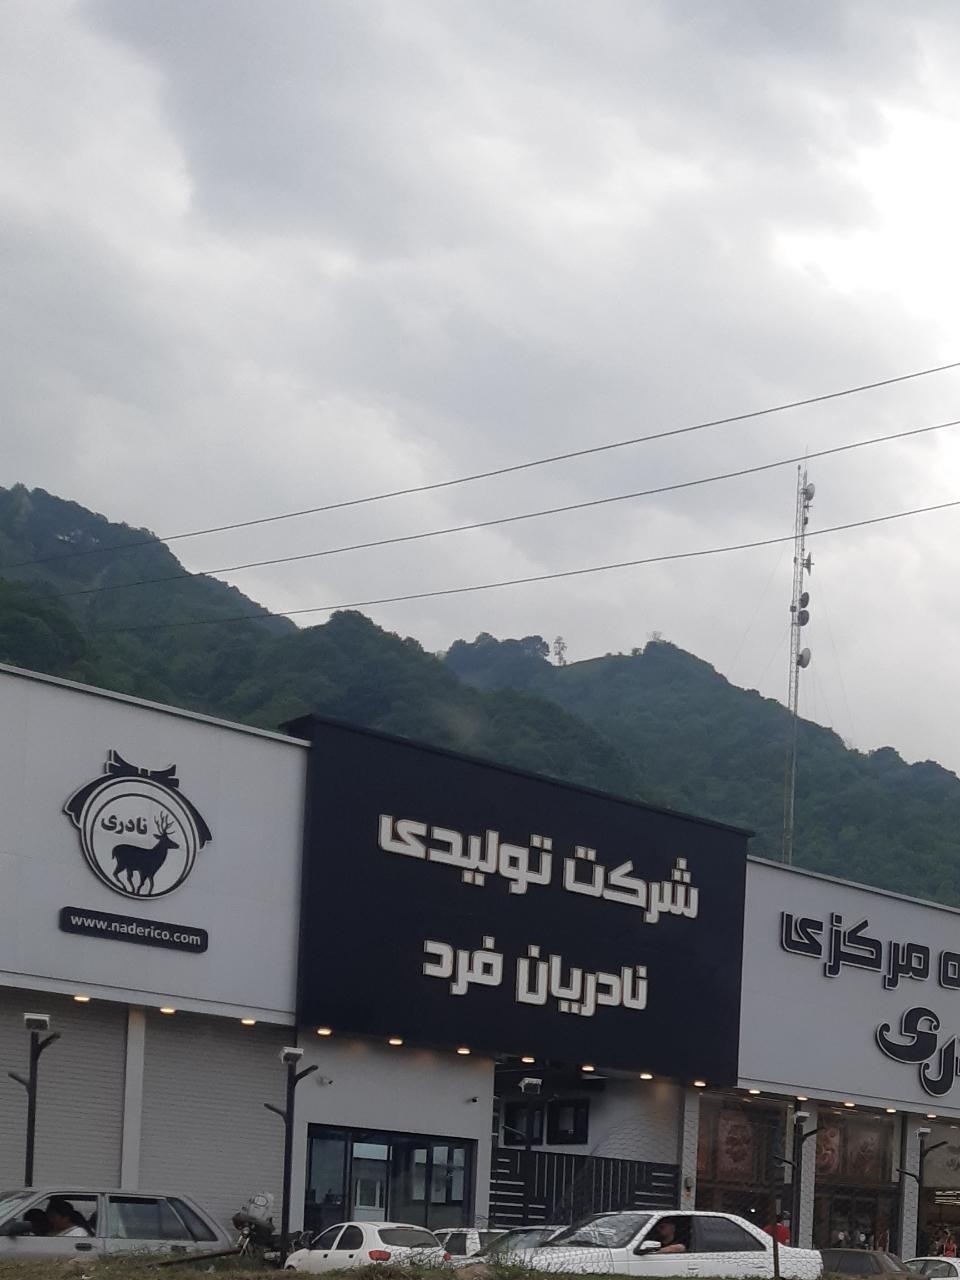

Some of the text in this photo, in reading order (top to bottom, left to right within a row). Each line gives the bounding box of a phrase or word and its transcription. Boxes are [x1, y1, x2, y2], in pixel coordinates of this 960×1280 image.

[101, 814, 148, 835] نادری
[377, 813, 699, 924] شرکت تولیدی
[70, 914, 201, 946] www.naderico.com
[781, 911, 930, 990] مرکزی
[422, 935, 648, 1018] نادریان فرد
